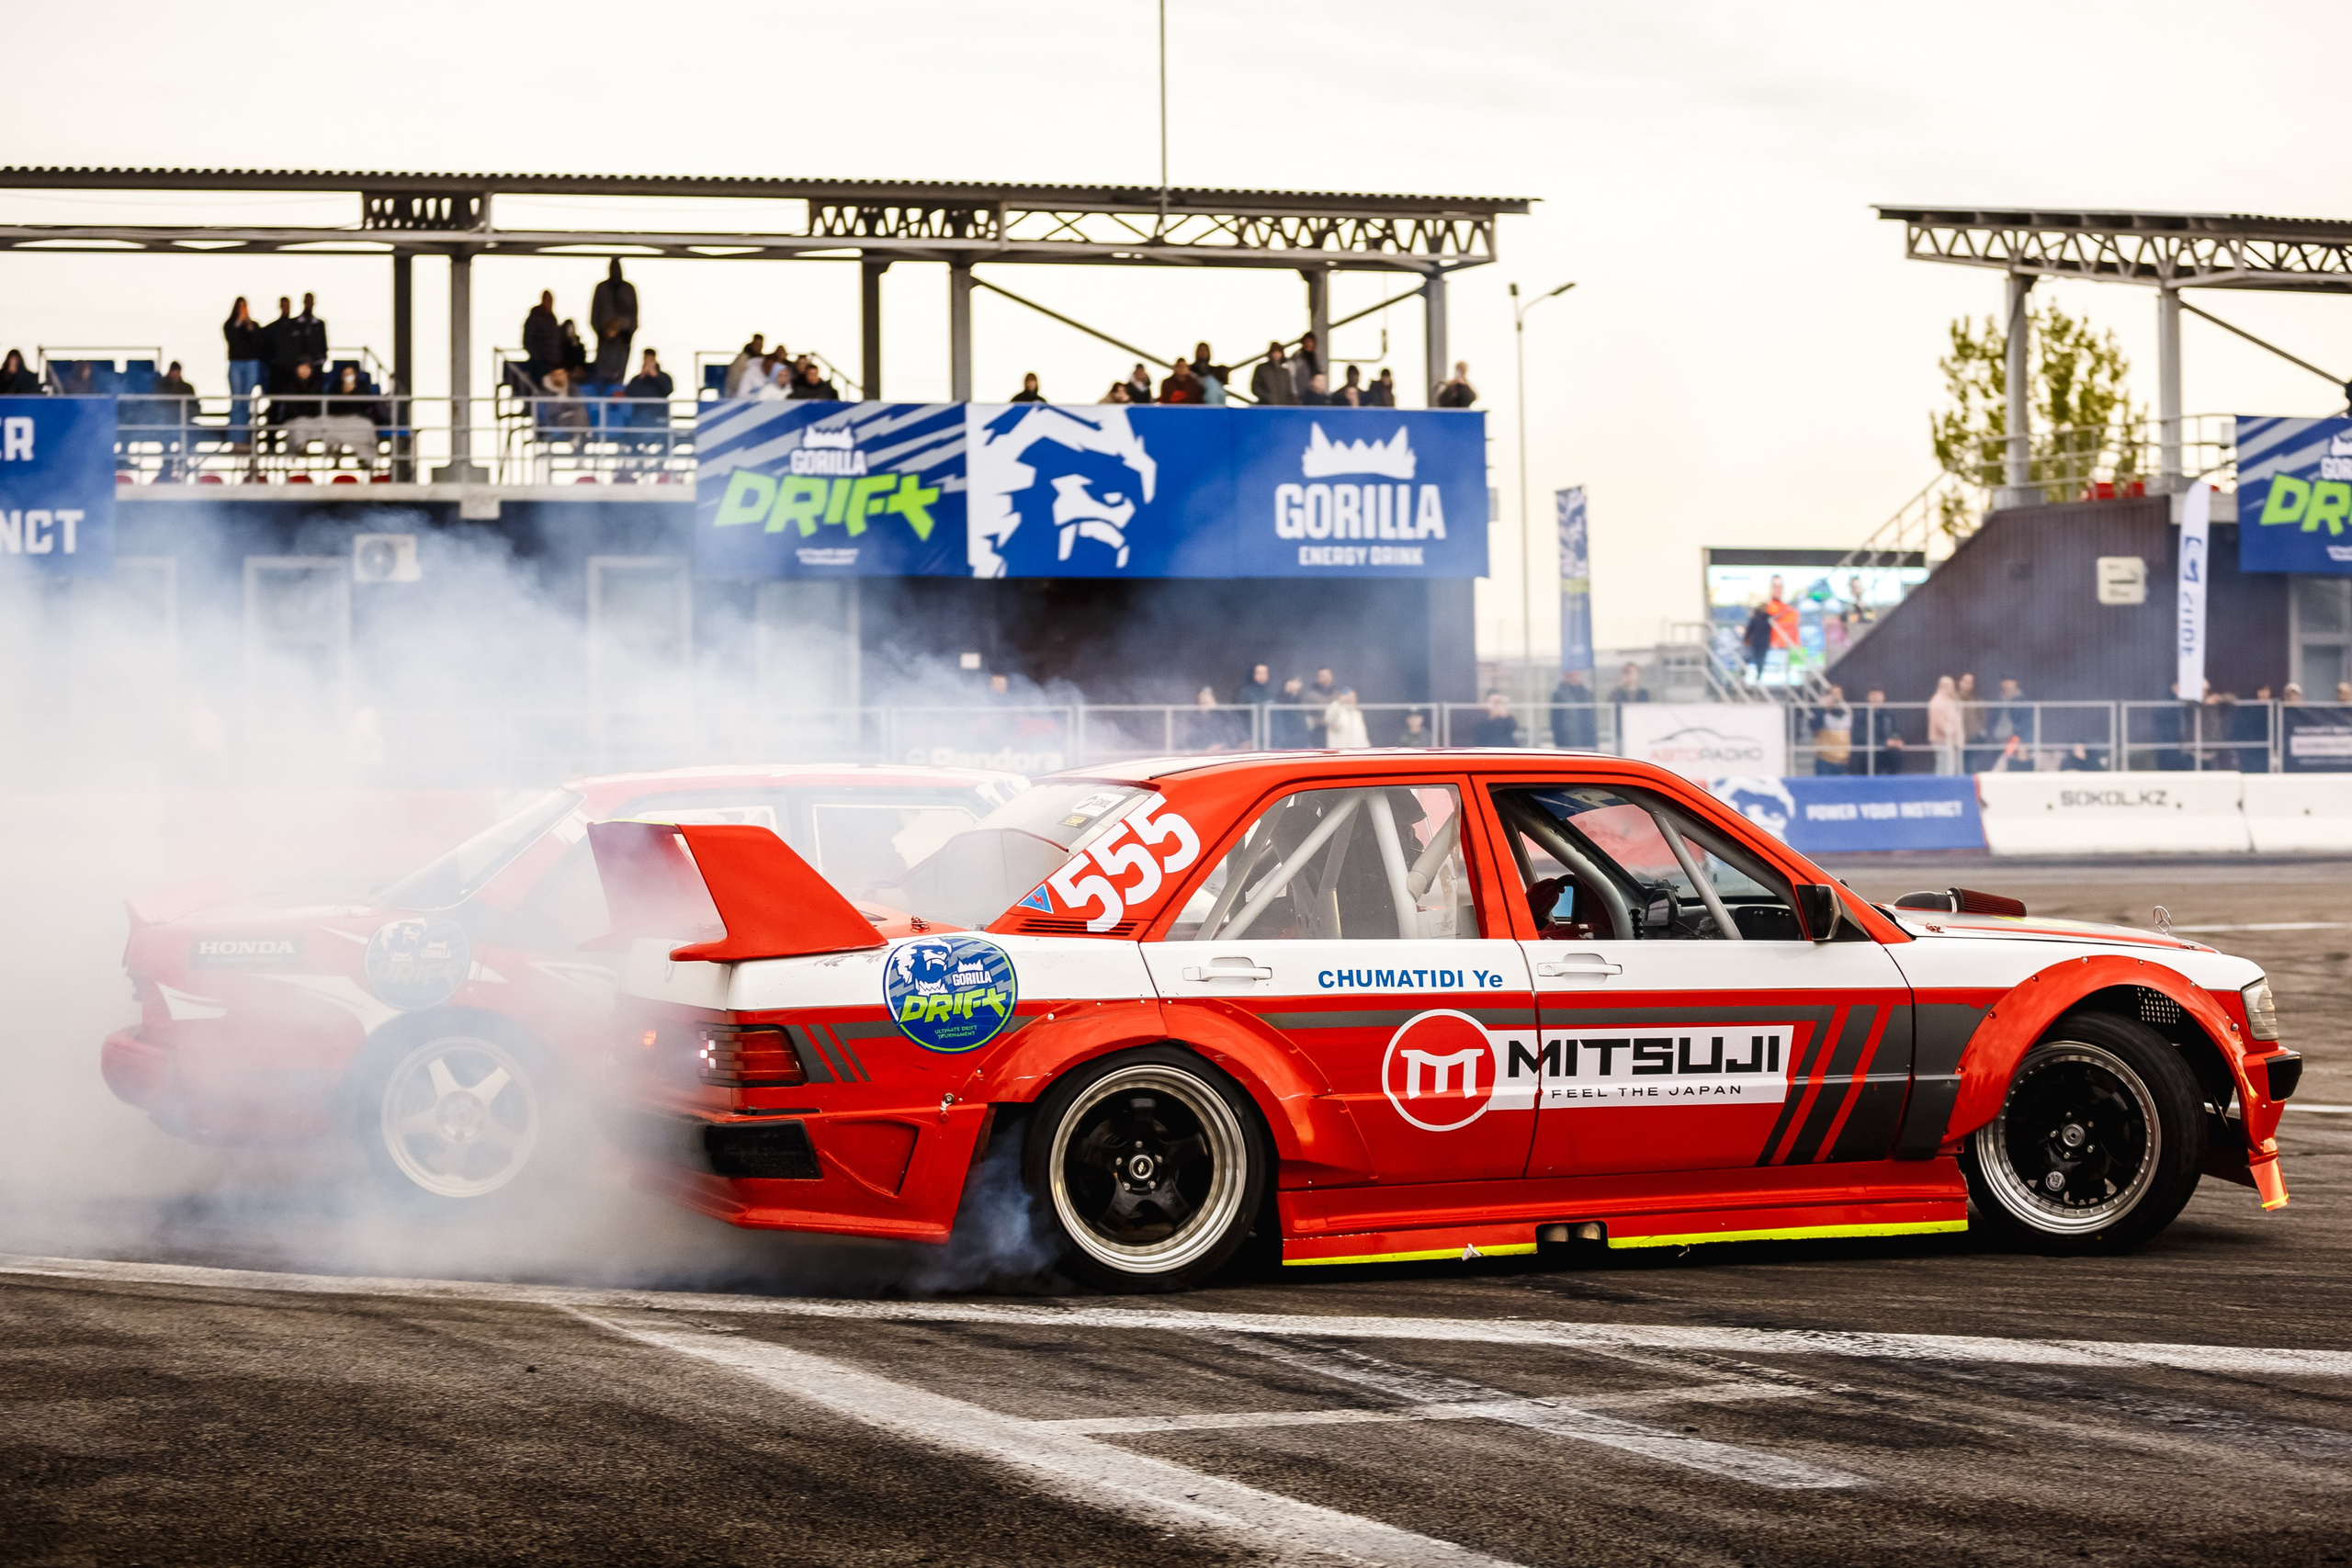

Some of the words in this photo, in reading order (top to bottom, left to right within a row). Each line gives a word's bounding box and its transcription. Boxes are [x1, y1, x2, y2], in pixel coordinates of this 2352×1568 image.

[0, 416, 34, 460] R
[790, 449, 867, 475] GORILLA
[713, 470, 940, 540] DRIFT
[1274, 483, 1447, 539] GORILLA
[2259, 474, 2352, 535] DR
[1298, 547, 1366, 566] ENERGY
[1370, 547, 1424, 566] DRINK
[1047, 792, 1201, 932] 555
[198, 941, 295, 954] HONDA
[420, 949, 451, 959] GORILLA
[952, 971, 992, 987] GORILLA
[1317, 969, 1464, 988] CHUMATIDI
[1473, 970, 1503, 987] Ye
[899, 987, 1007, 1022] DRIFT
[1508, 1035, 1781, 1077] MITSUJI
[1551, 1089, 1608, 1099] FEEL
[1618, 1087, 1659, 1097] THE
[1668, 1085, 1741, 1096] JAPAN
